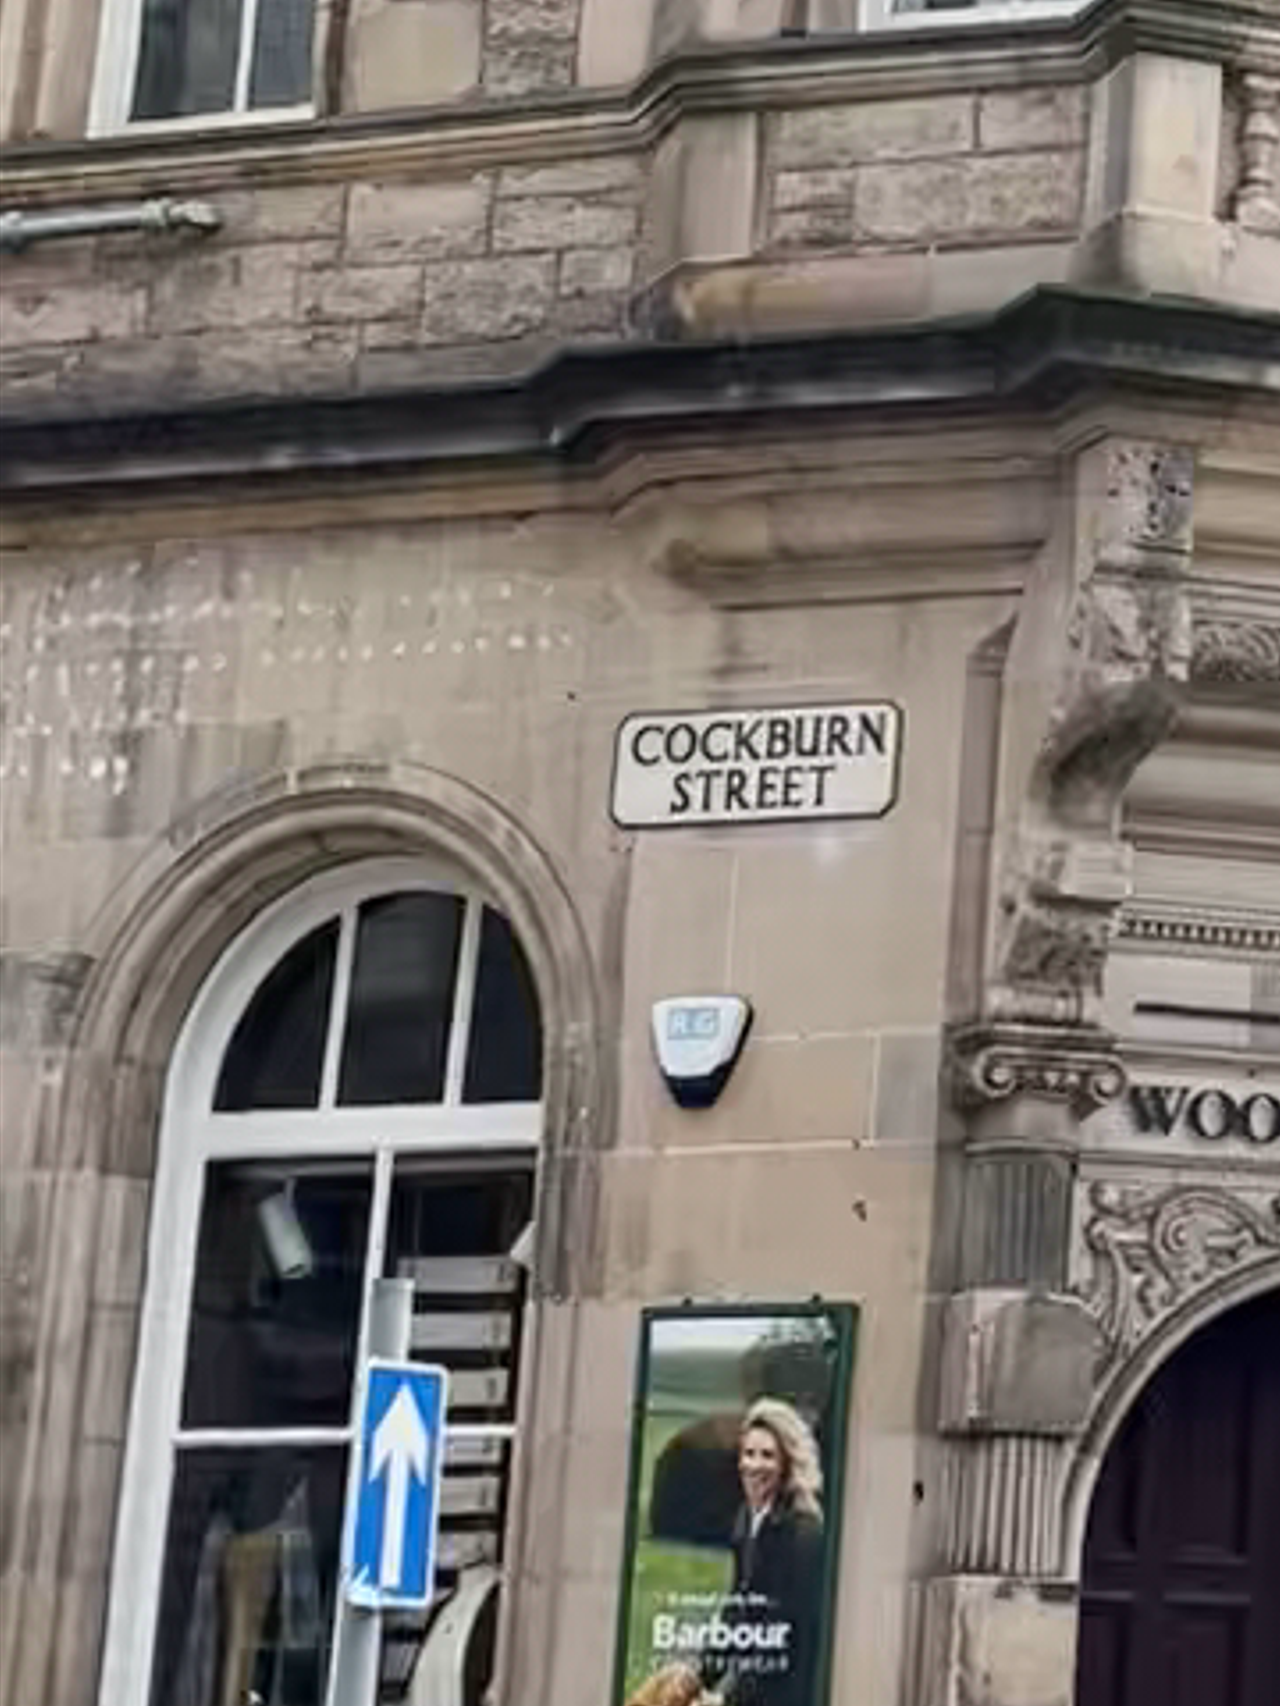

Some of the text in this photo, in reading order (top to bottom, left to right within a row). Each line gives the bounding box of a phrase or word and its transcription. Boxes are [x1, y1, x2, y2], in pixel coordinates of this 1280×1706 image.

[632, 712, 885, 766] COCKBURN
[670, 766, 836, 813] STREET
[653, 1614, 791, 1649] Barbour
